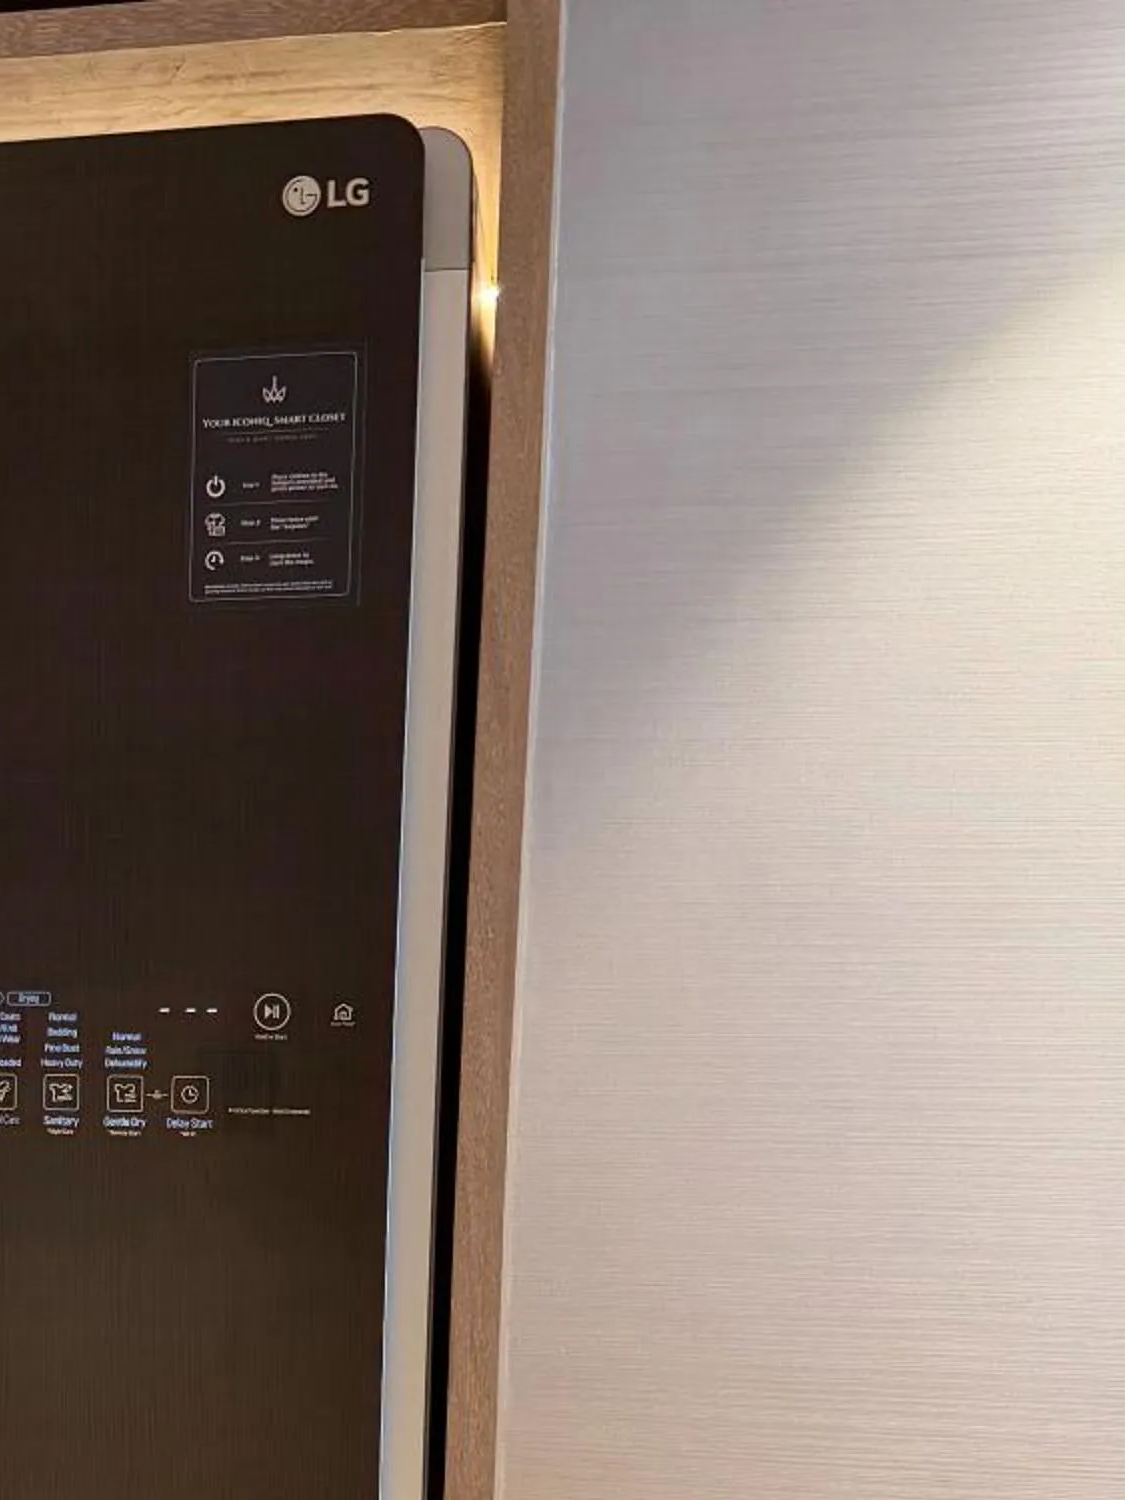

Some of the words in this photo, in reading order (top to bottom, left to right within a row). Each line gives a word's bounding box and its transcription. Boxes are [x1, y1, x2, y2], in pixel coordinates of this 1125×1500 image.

[327, 178, 370, 208] LG
[202, 417, 230, 429] YOUR
[275, 414, 306, 425] SMART
[308, 412, 346, 423] CLOSET
[46, 1027, 78, 1039] Bedding
[165, 1116, 190, 1130] Delay
[190, 1116, 214, 1129] Start
